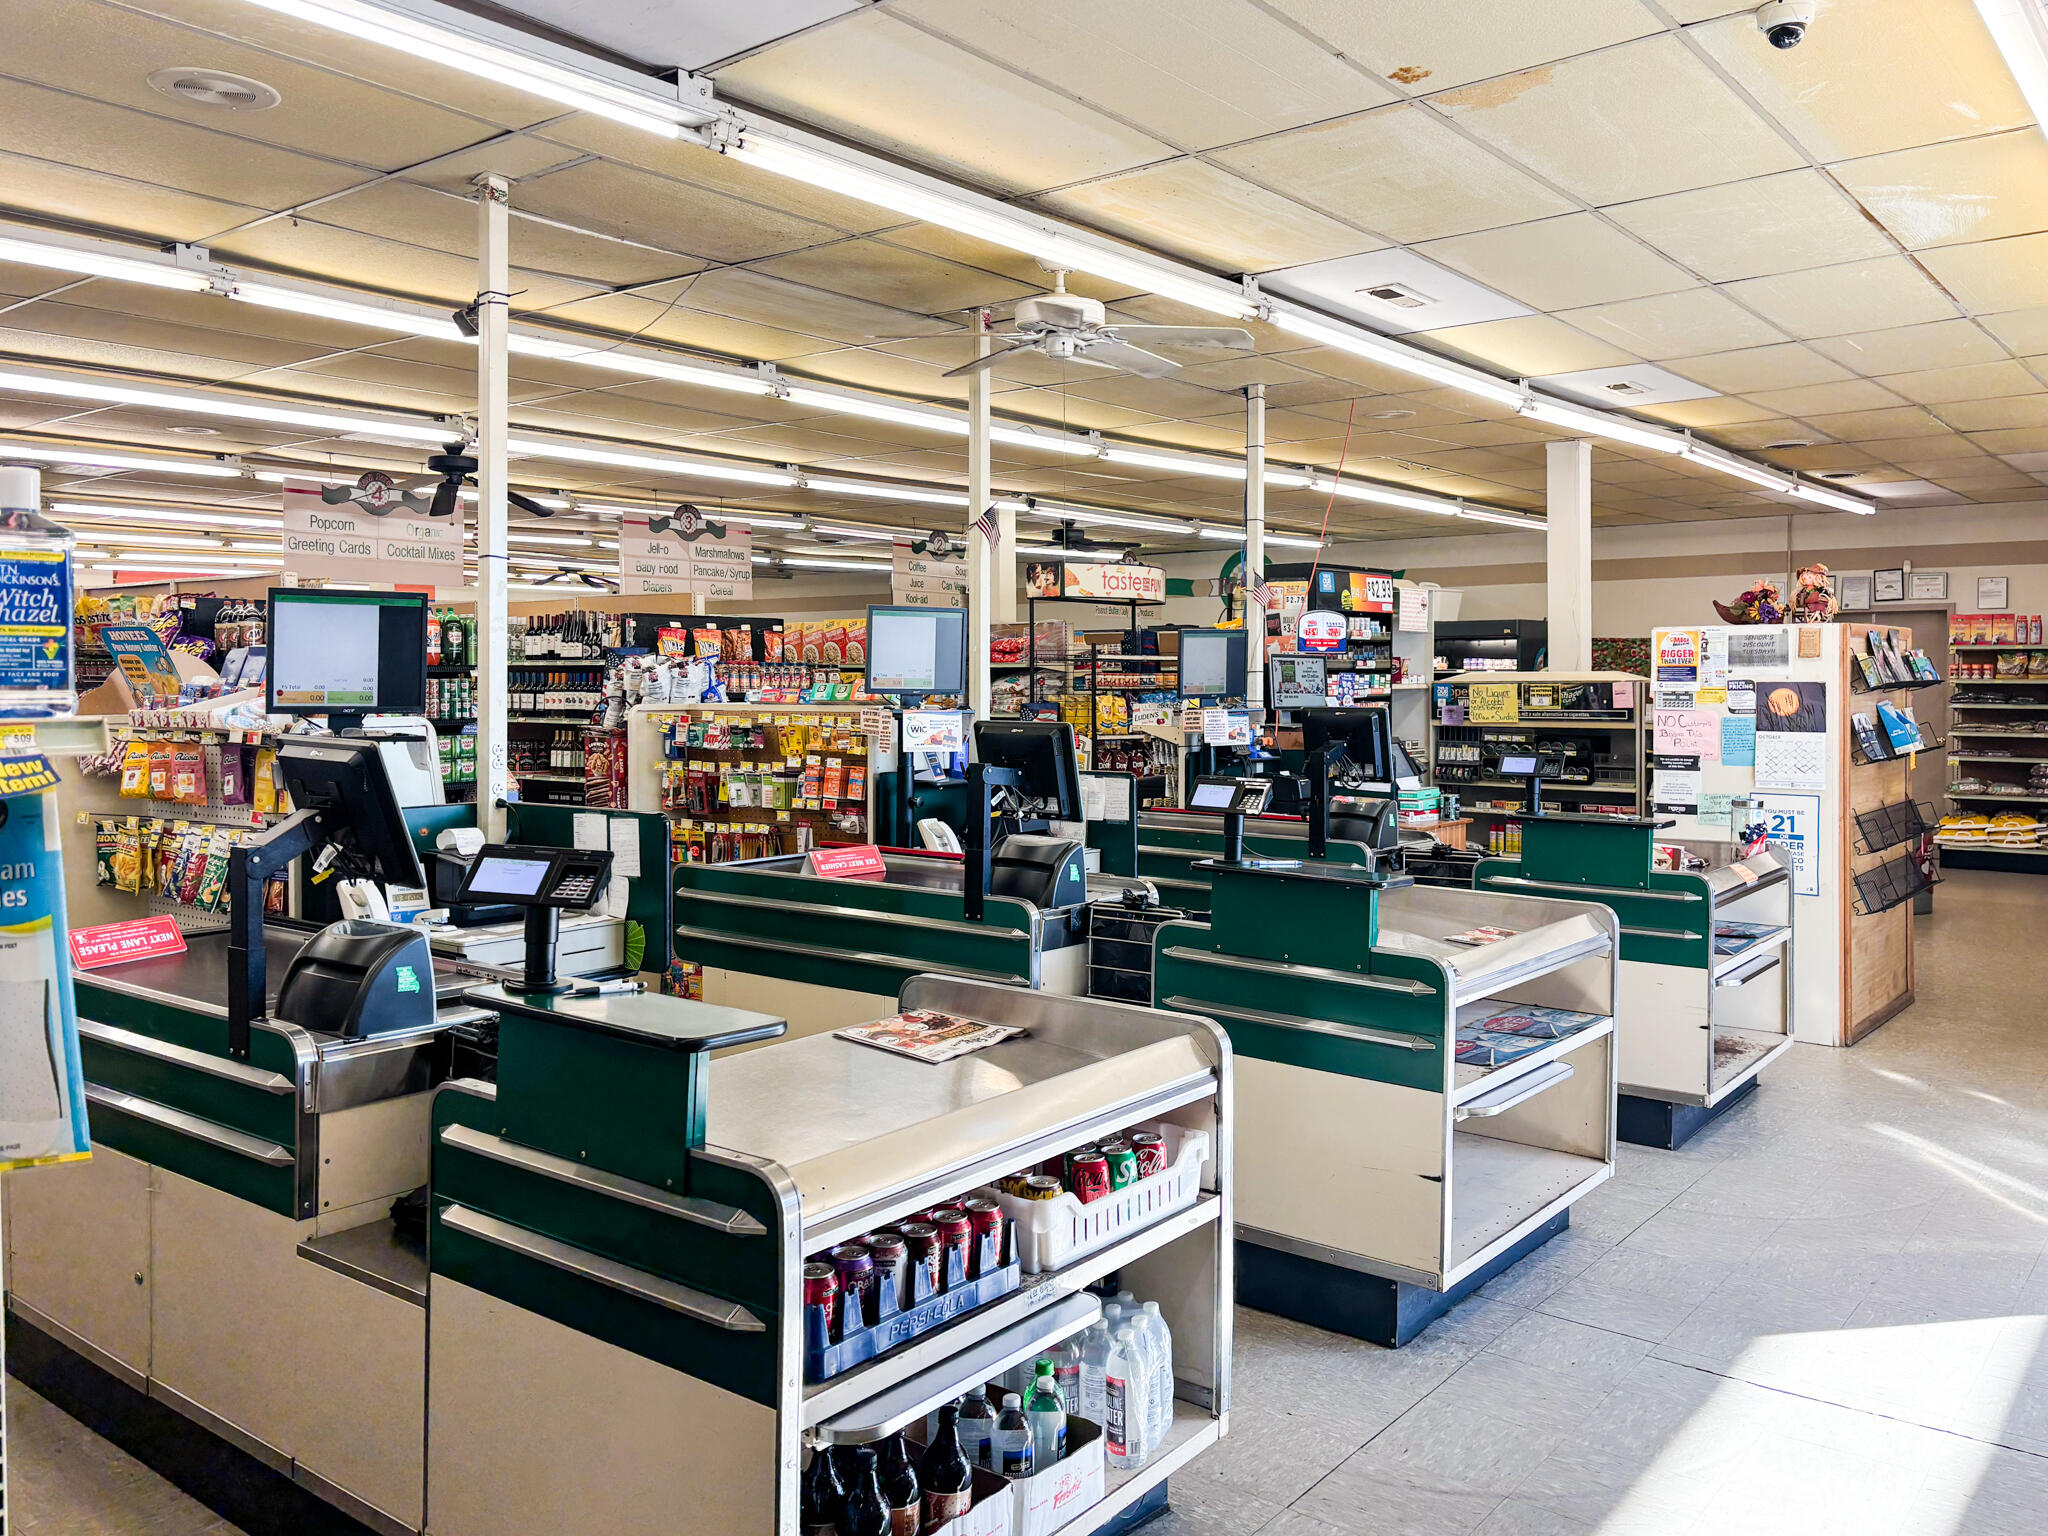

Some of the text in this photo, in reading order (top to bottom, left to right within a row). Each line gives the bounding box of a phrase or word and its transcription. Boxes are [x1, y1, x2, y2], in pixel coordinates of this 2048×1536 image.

[371, 484, 383, 502] 4
[310, 514, 355, 532] Popcorn
[685, 516, 693, 530] 3
[288, 536, 371, 556] Greeting Cards
[387, 543, 456, 561] Cocktail Mixes
[647, 542, 669, 555] Jell-o
[936, 539, 943, 552] 2
[695, 546, 745, 561] Marshmallows
[908, 561, 927, 573] Coffee
[909, 578, 924, 589] Juice
[941, 581, 953, 591] Can
[1102, 570, 1142, 591] taste
[905, 593, 928, 605] Kool-aid
[108, 630, 149, 641] HONEES
[1660, 649, 1694, 658] BIGGER
[1472, 687, 1511, 699] No Liquor
[1134, 711, 1160, 722] LUDEN'S
[1657, 715, 1676, 728] NO
[910, 725, 928, 733] WIC
[174, 752, 200, 761] Ricola
[1771, 815, 1795, 833] 21
[121, 936, 147, 949] LANE
[150, 931, 175, 944] NEXT
[78, 942, 118, 956] PLEASE
